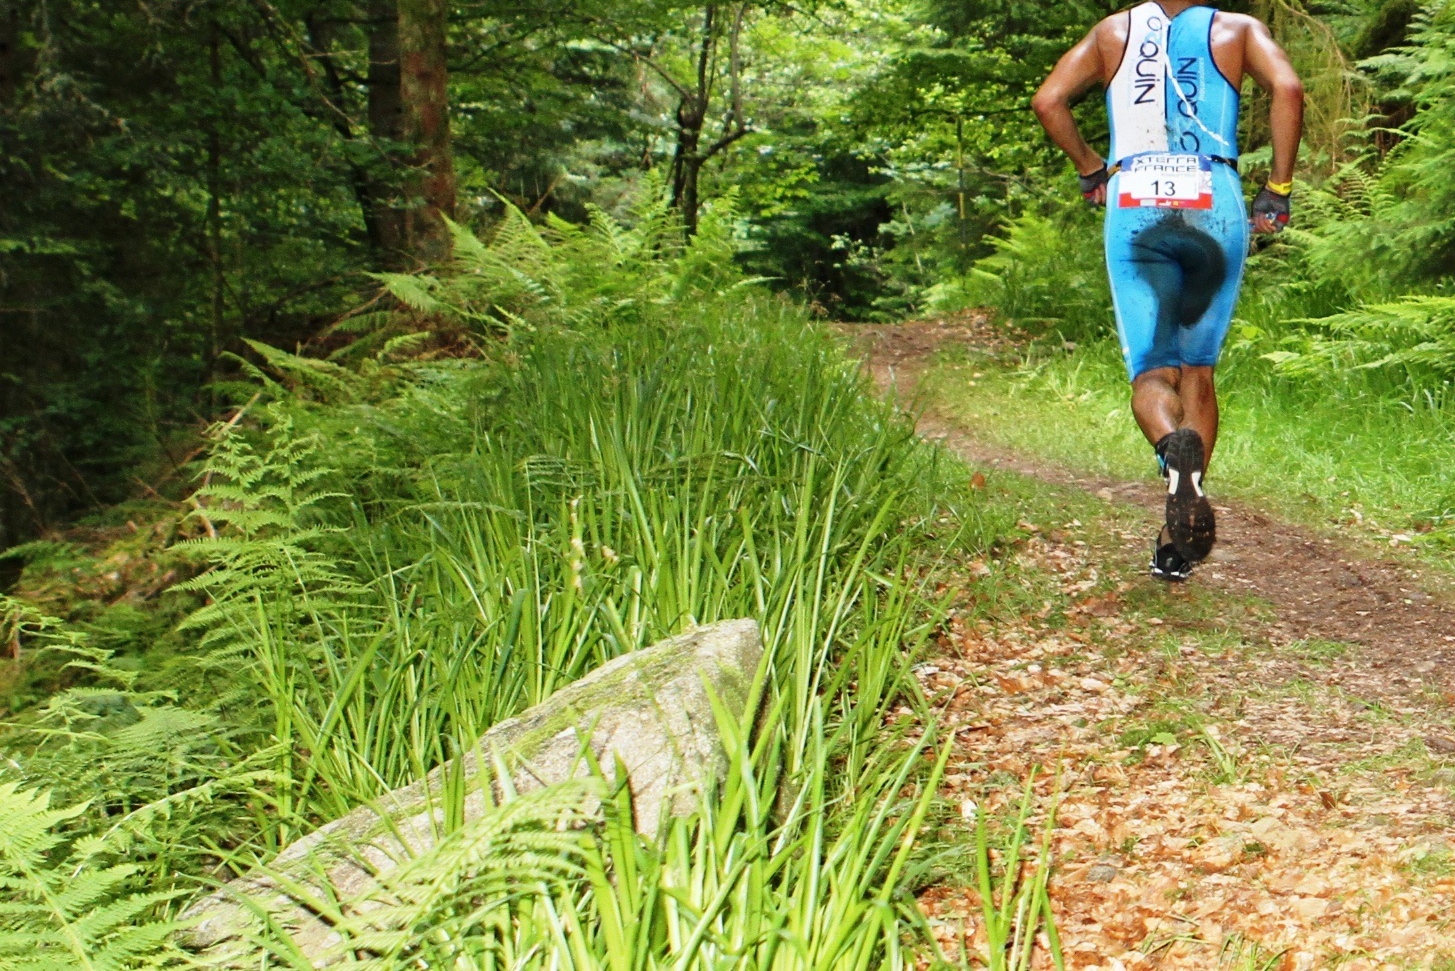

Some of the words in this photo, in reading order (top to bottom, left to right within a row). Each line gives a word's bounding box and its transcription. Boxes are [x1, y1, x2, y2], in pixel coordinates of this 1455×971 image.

[1136, 156, 1197, 165] XTERRA
[1135, 164, 1197, 173] FRANCE
[1150, 180, 1176, 197] 13
